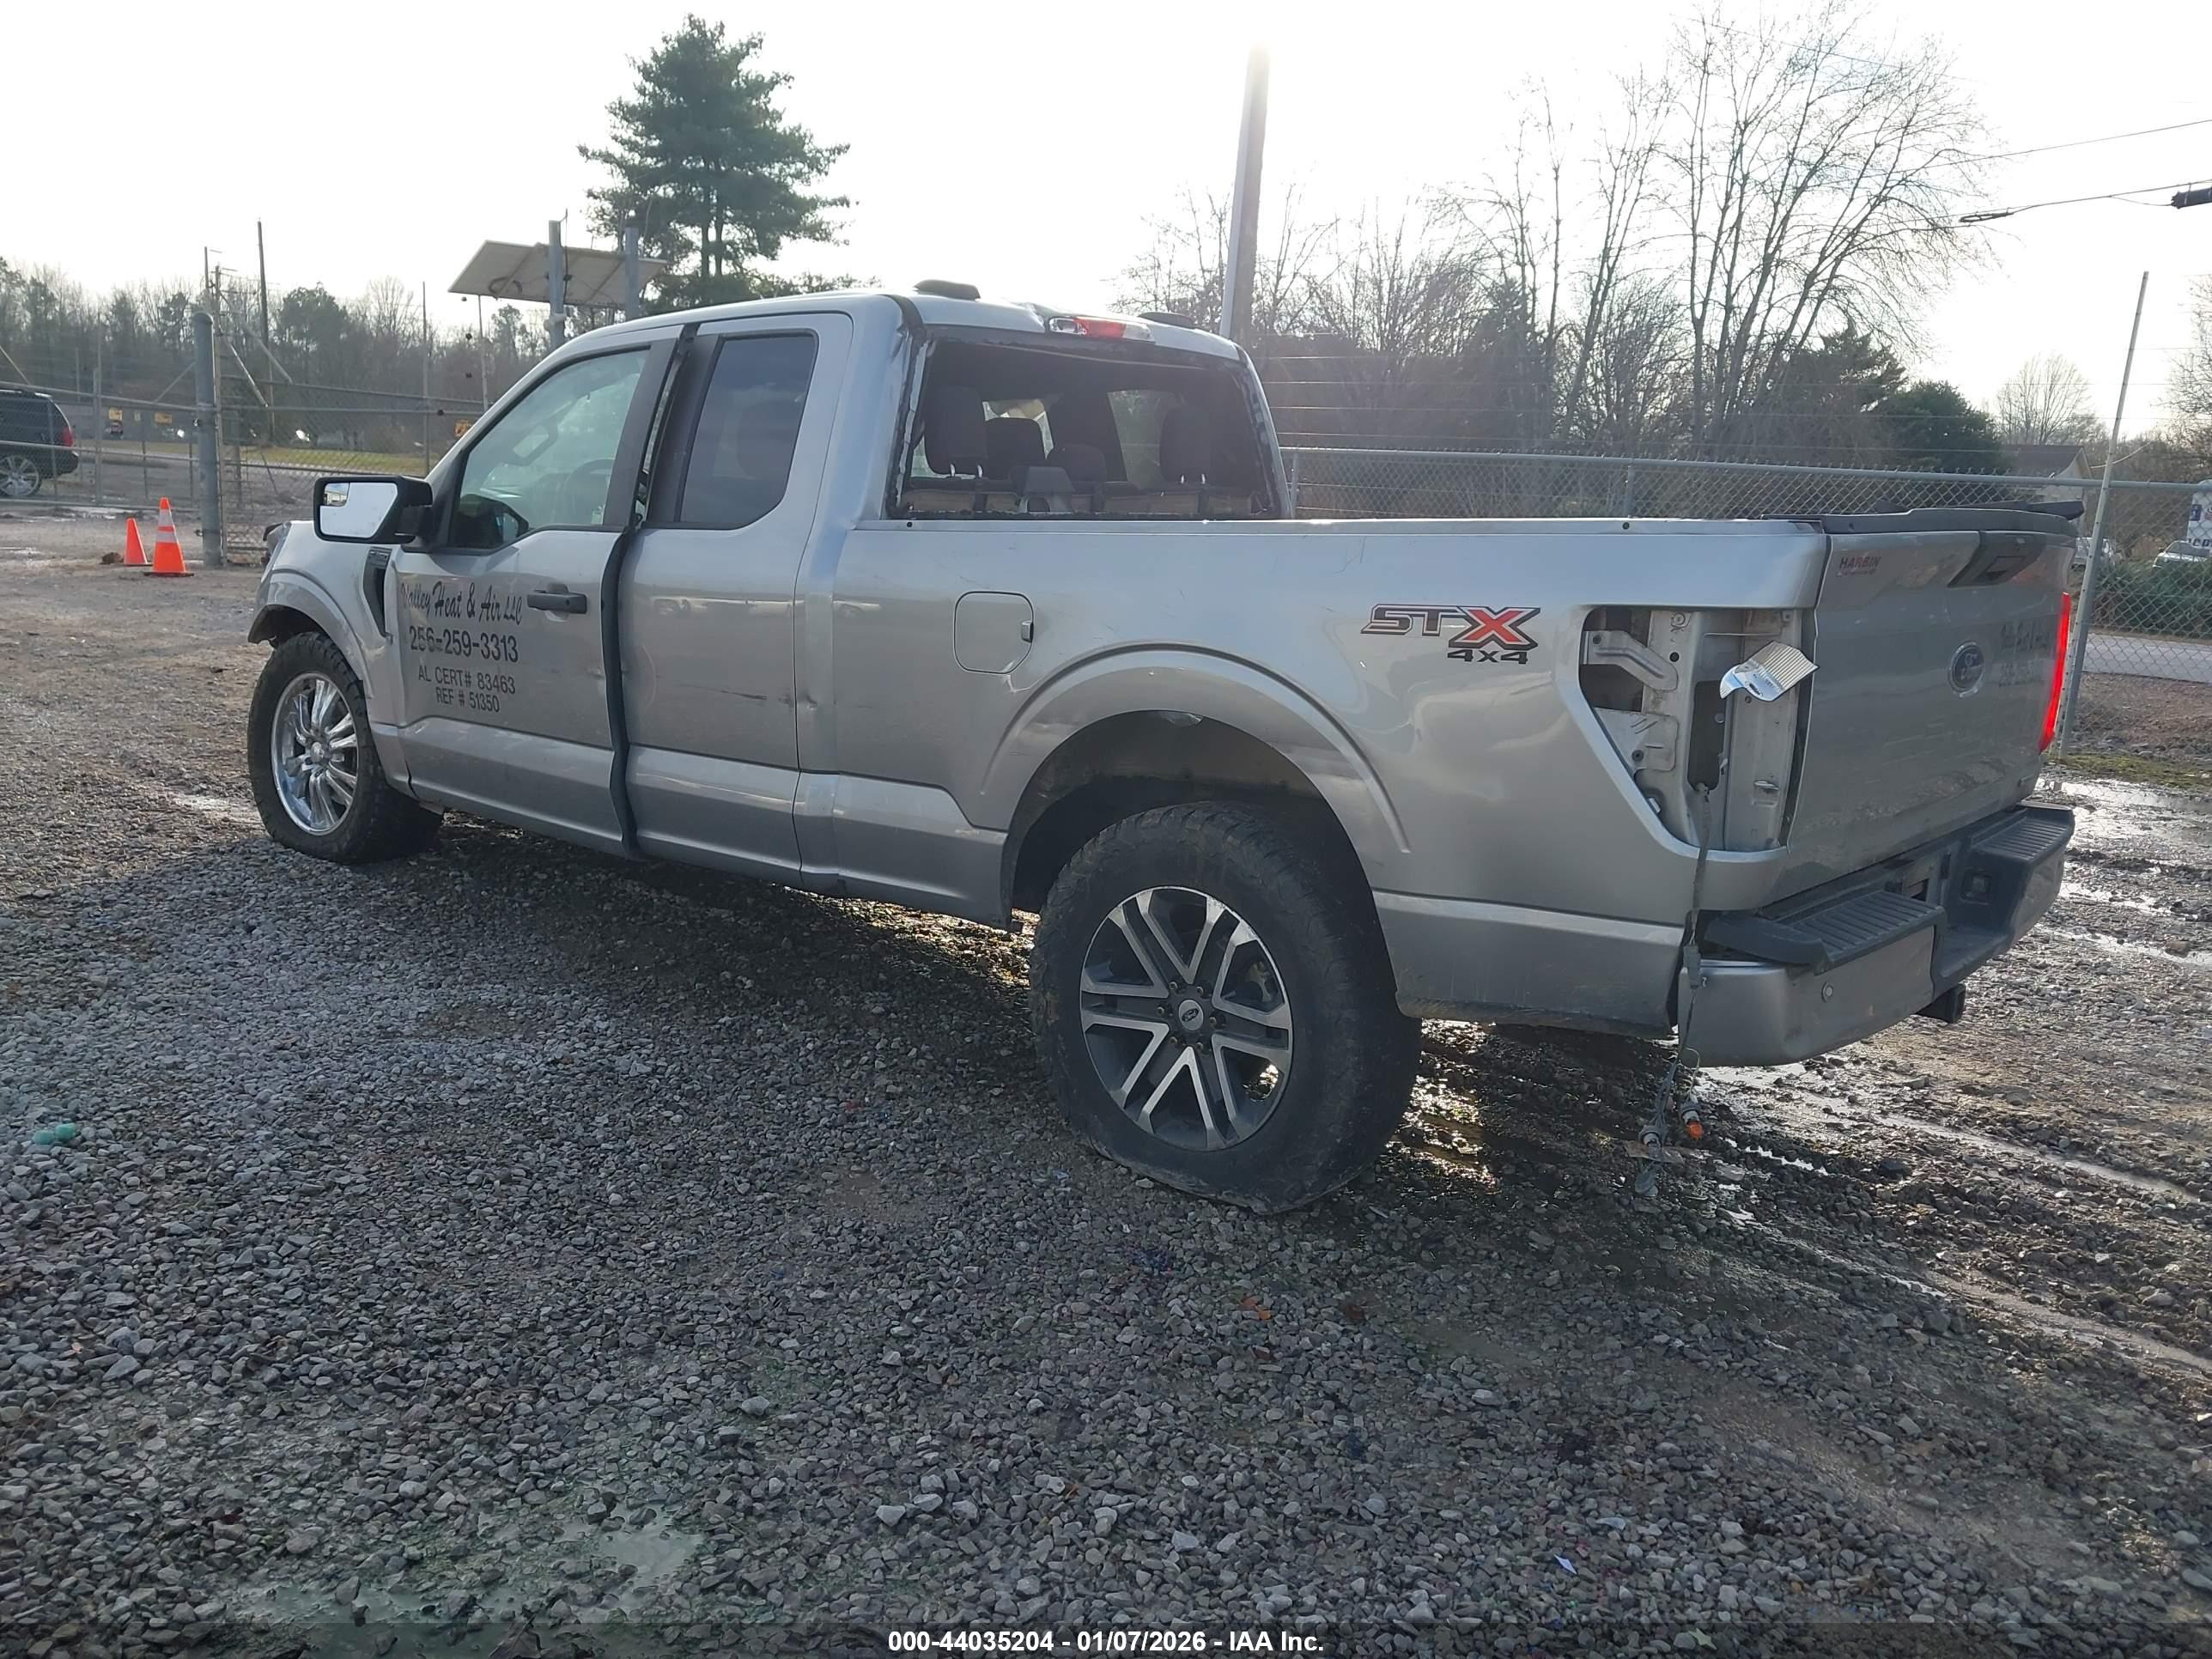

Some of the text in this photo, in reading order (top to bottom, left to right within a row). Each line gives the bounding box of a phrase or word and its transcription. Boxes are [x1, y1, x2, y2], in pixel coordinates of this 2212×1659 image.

[432, 581, 462, 618] Heat
[466, 582, 476, 618] &
[479, 585, 501, 623] Air
[503, 596, 523, 625] LLC
[409, 625, 519, 663] 256-259-3313
[1360, 604, 1541, 651] STX
[418, 665, 432, 683] AL
[477, 672, 516, 695] 83463
[435, 687, 501, 713] REF # 51350
